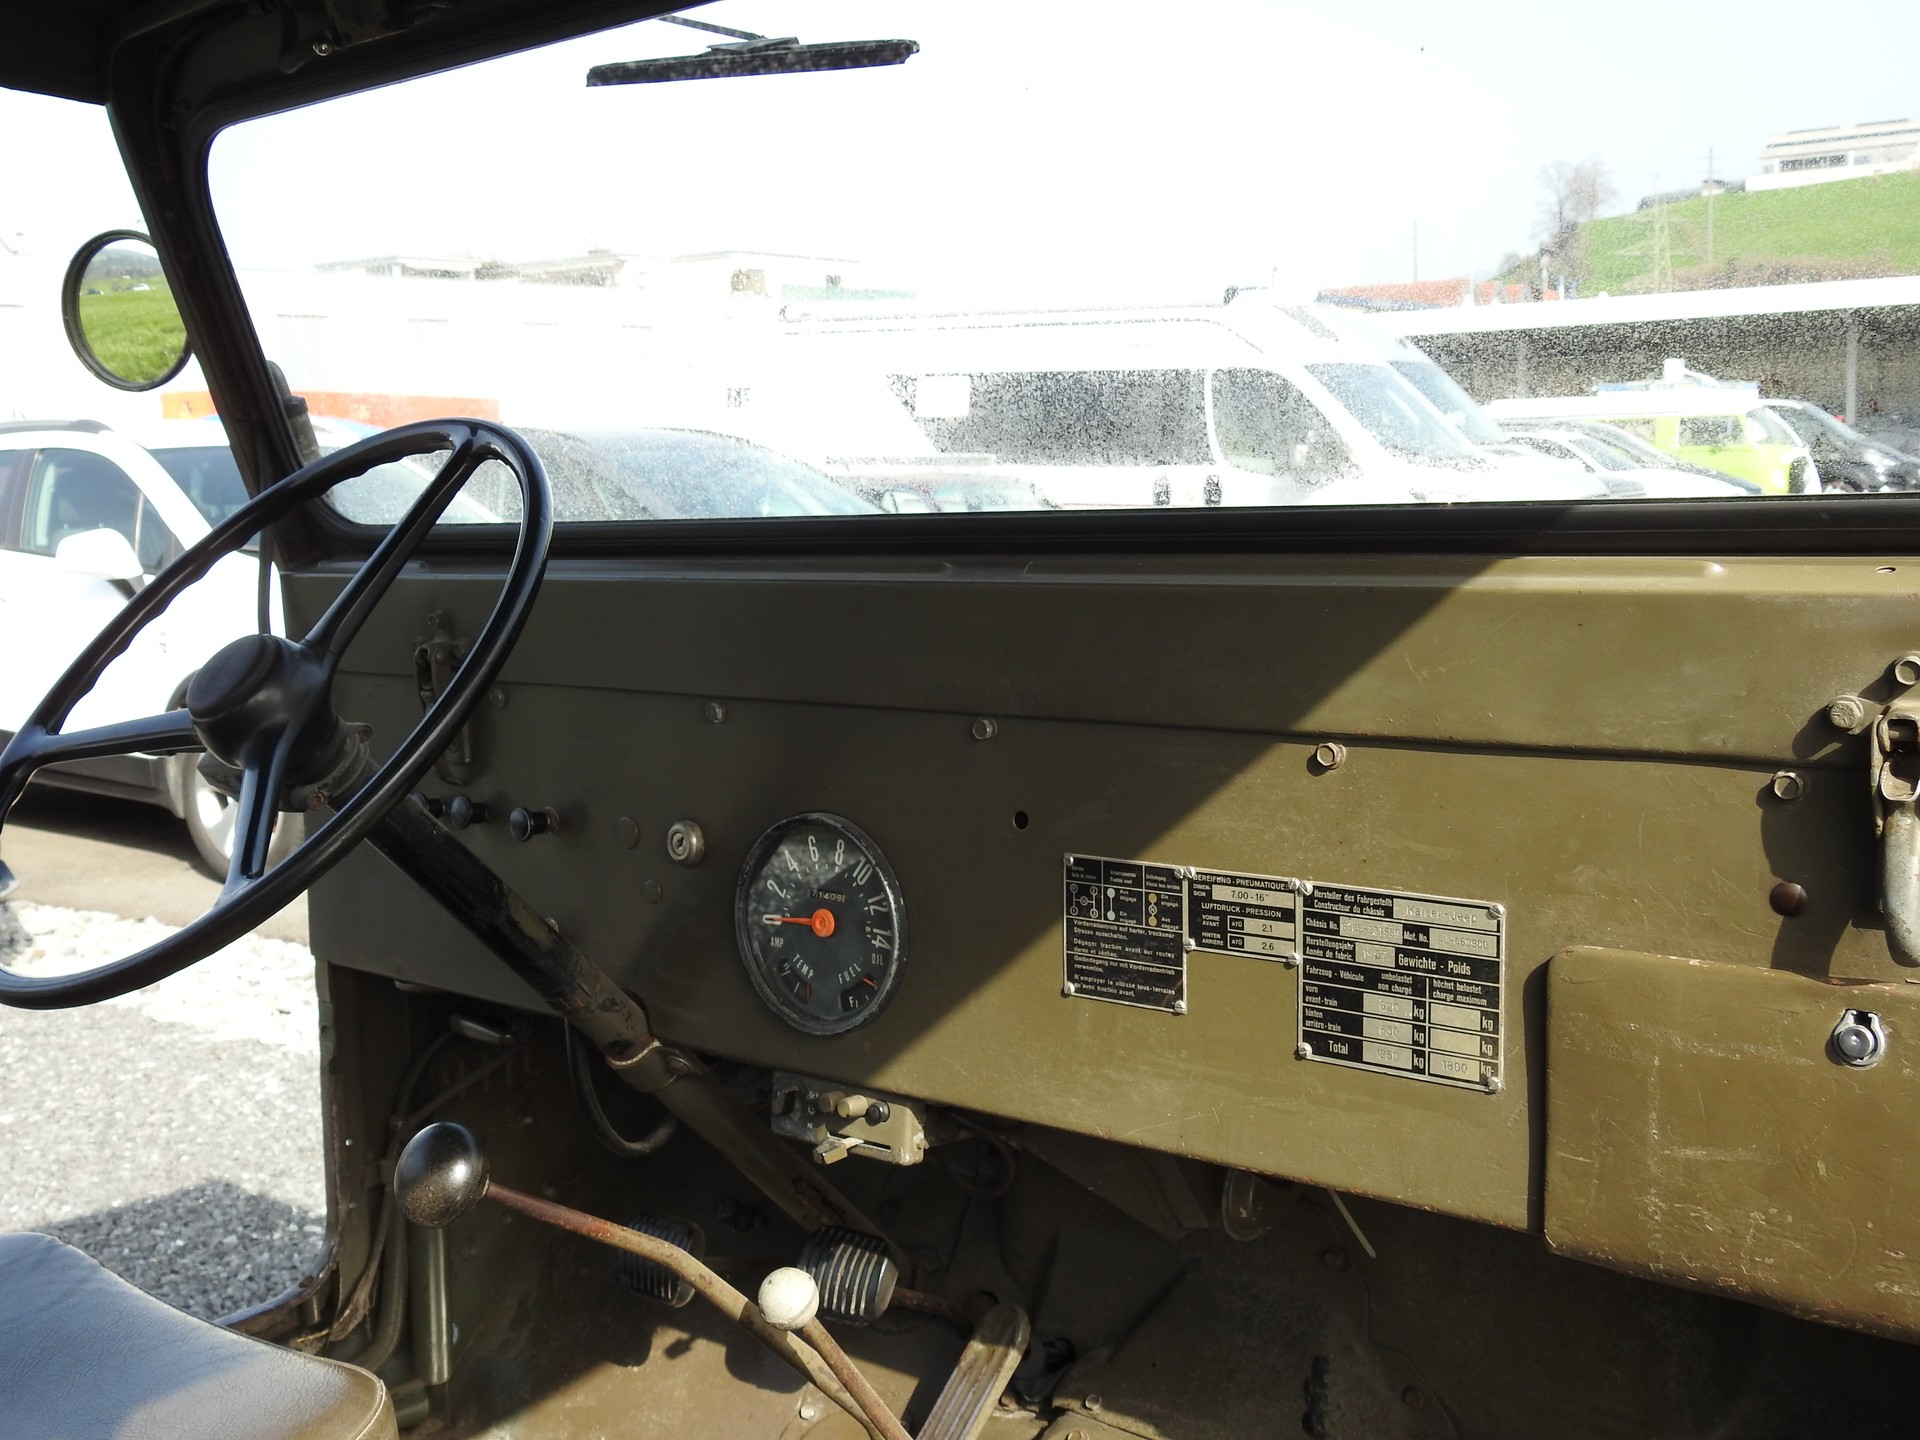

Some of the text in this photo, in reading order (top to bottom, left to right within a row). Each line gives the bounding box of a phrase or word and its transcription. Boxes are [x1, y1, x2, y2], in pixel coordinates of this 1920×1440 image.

[808, 835, 819, 862] 6
[834, 839, 845, 865] 8
[784, 850, 800, 872] 4
[852, 856, 874, 886] 10
[1193, 874, 1231, 884] BEREIFUNG
[766, 879, 787, 899] 2
[1231, 890, 1249, 900] 7.00
[867, 891, 890, 916] 12
[1314, 889, 1393, 907] Hersteller des Fahrgestells
[1201, 902, 1240, 914] LUFTDRUCK
[1245, 908, 1282, 918] PRESSION
[1314, 899, 1351, 912] Constructeur
[1353, 905, 1361, 913] du
[1261, 924, 1273, 933] 2.1
[1329, 920, 1339, 931] No.
[770, 936, 784, 949] AMP
[871, 928, 893, 950] 14
[1305, 936, 1354, 951] Herstellungsjahr
[1403, 930, 1429, 943] Mot. No.
[1261, 941, 1275, 951] 2.6
[871, 953, 883, 966] OIL
[1156, 950, 1175, 959] routes
[1325, 949, 1333, 958] de
[1335, 950, 1354, 961] fabric.
[792, 954, 814, 979] TEMP
[1398, 953, 1437, 970] Gewichte
[1447, 960, 1471, 975] Poids
[838, 962, 862, 985] FUEL
[1306, 965, 1332, 978] Fahrzeug
[1339, 970, 1365, 982] Véhicule
[1381, 972, 1413, 984] unbelastet
[1305, 985, 1319, 994] vorn
[1377, 983, 1389, 991] non
[1456, 982, 1482, 994] belastet
[1456, 995, 1487, 1006] maximum
[1305, 1007, 1323, 1019] hinten
[1413, 1005, 1424, 1020] kg
[1482, 1016, 1493, 1031] kg
[1413, 1029, 1424, 1044] kg
[1328, 1040, 1349, 1055] Total
[1413, 1054, 1424, 1069] kg
[1481, 1041, 1493, 1056] kg
[1441, 1060, 1468, 1073] 1800
